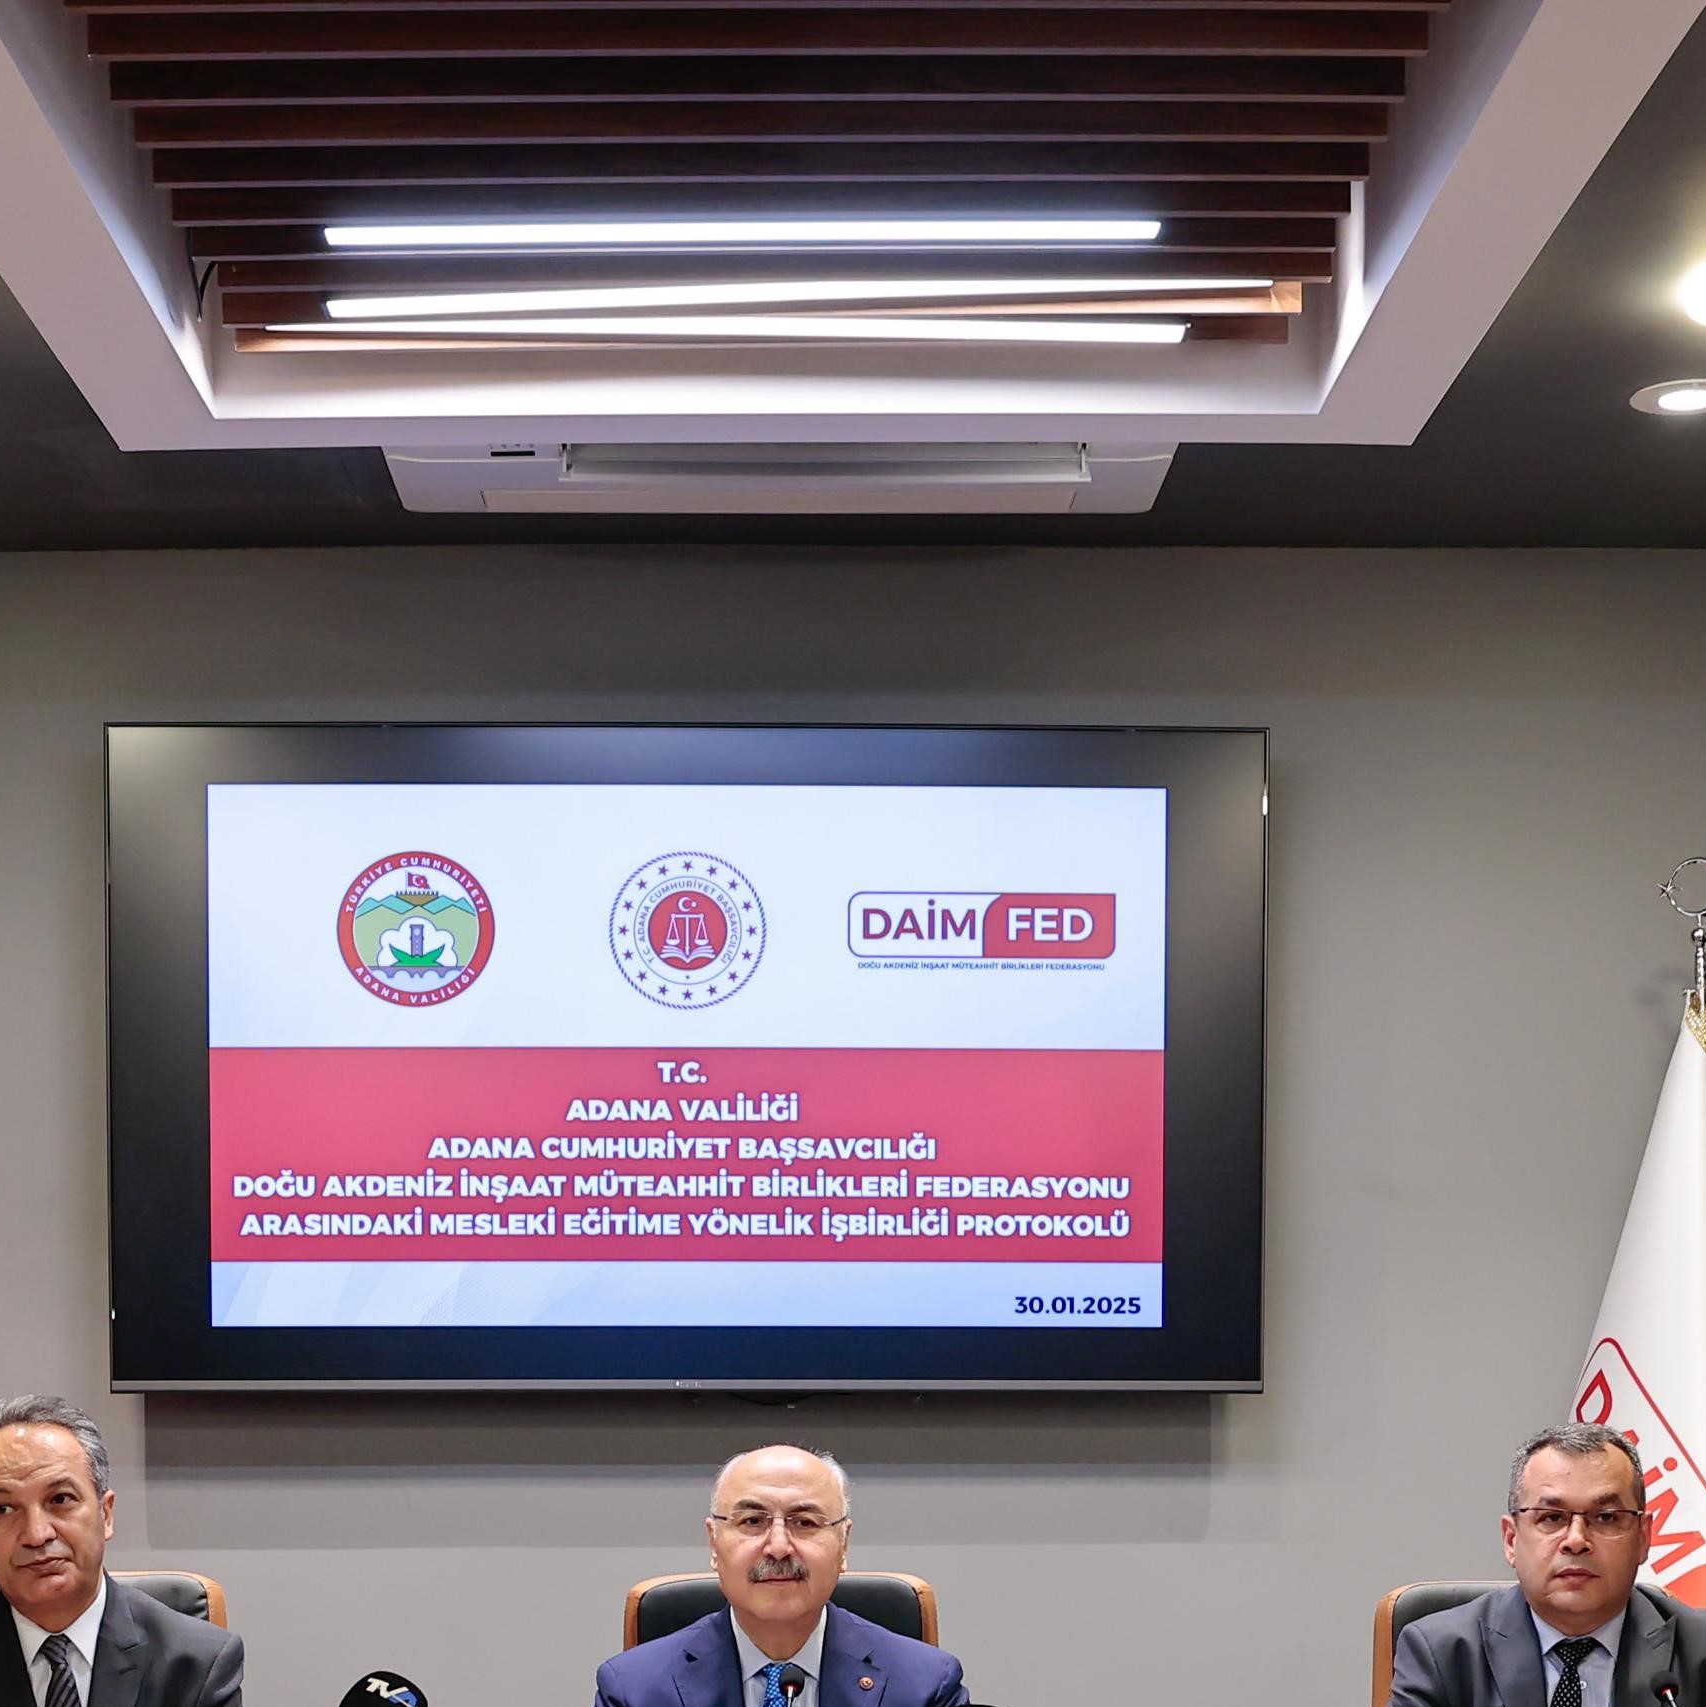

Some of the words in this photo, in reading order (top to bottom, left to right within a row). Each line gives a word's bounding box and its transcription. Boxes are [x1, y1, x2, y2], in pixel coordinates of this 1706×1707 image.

[862, 898, 976, 940] DAİM
[1006, 906, 1095, 942] FED
[883, 961, 919, 969] AKDENİZ
[656, 1060, 708, 1084] T.C.
[565, 1099, 673, 1121] ADANA
[679, 1091, 799, 1122] VALİLİĞİ
[427, 1137, 535, 1159] ADANA
[541, 1130, 731, 1160] CUMHURİYET
[737, 1132, 937, 1165] BAŞSAVCILIĞI
[233, 1169, 316, 1198] DOĞU
[322, 1168, 453, 1197] AKDENİZ
[459, 1168, 567, 1203] İNŞAAT
[573, 1168, 746, 1198] MÜTEAHHİT
[752, 1168, 909, 1199] BİRLİKLERİ
[915, 1175, 1131, 1200] FEDERASYONU
[240, 1206, 423, 1236] ARASINDAKİ
[429, 1206, 556, 1236] MESLEKİ
[563, 1206, 681, 1236] EĞİTİME
[687, 1207, 814, 1237] YÖNELİK
[821, 1206, 949, 1242] İŞBİRLİĞİ
[956, 1209, 1131, 1238] PROTOKOLÜ
[1013, 1296, 1142, 1316] 30.01.2025
[1576, 1369, 1706, 1575] DİM
